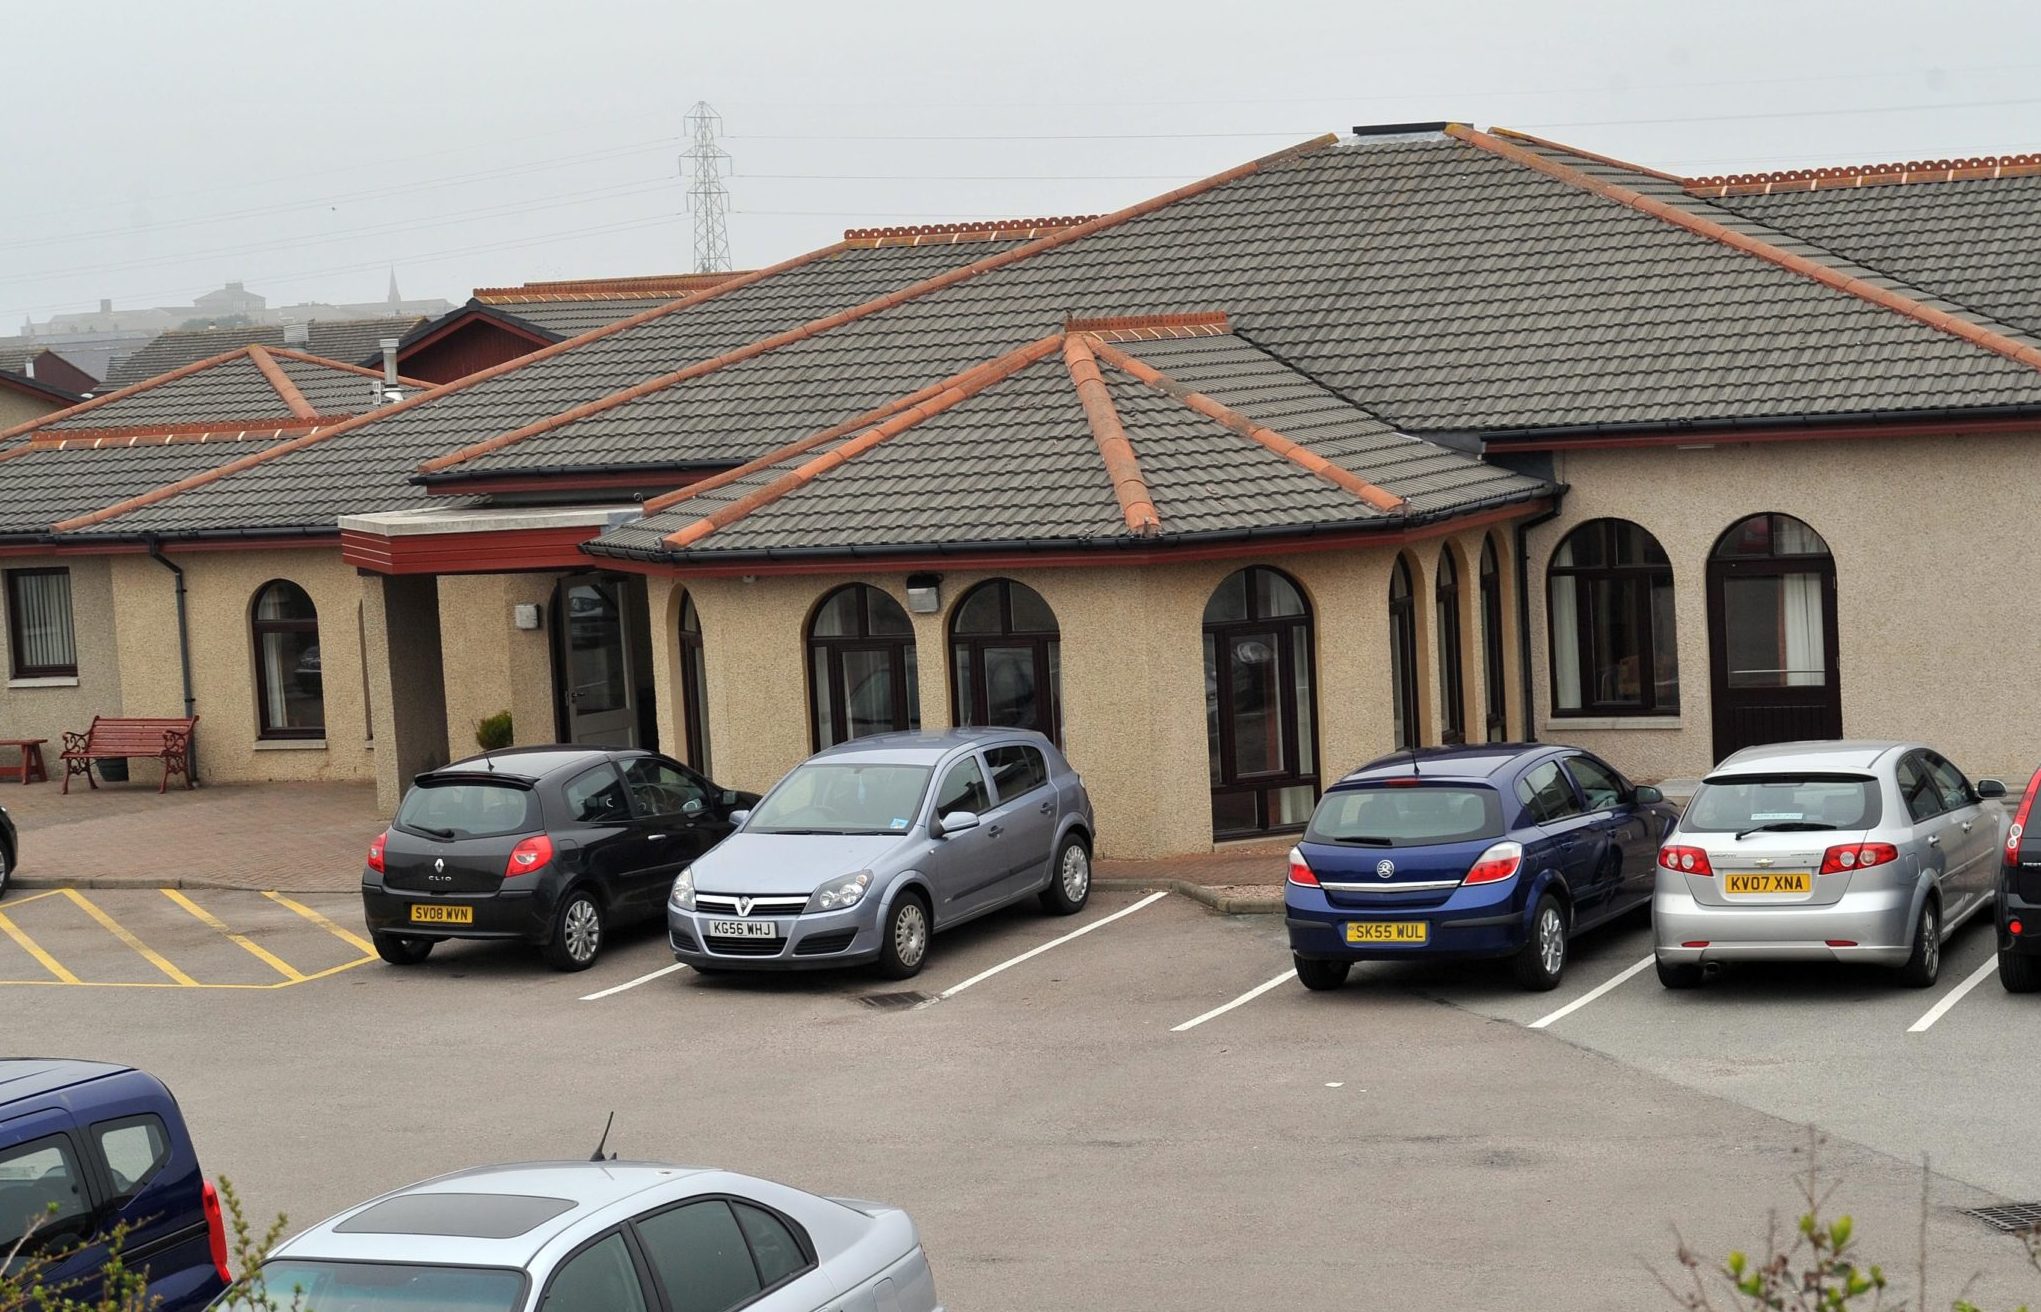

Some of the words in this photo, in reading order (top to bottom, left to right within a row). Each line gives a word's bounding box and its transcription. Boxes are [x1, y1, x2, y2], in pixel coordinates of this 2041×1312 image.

[1731, 876, 1769, 890] KV07
[1774, 876, 1803, 890] XNA
[415, 906, 443, 919] SV08
[446, 907, 468, 921] WVN
[714, 921, 744, 935] KG56
[747, 922, 770, 936] WHJ
[1356, 924, 1392, 938] SK55
[1397, 924, 1423, 938] WUL
